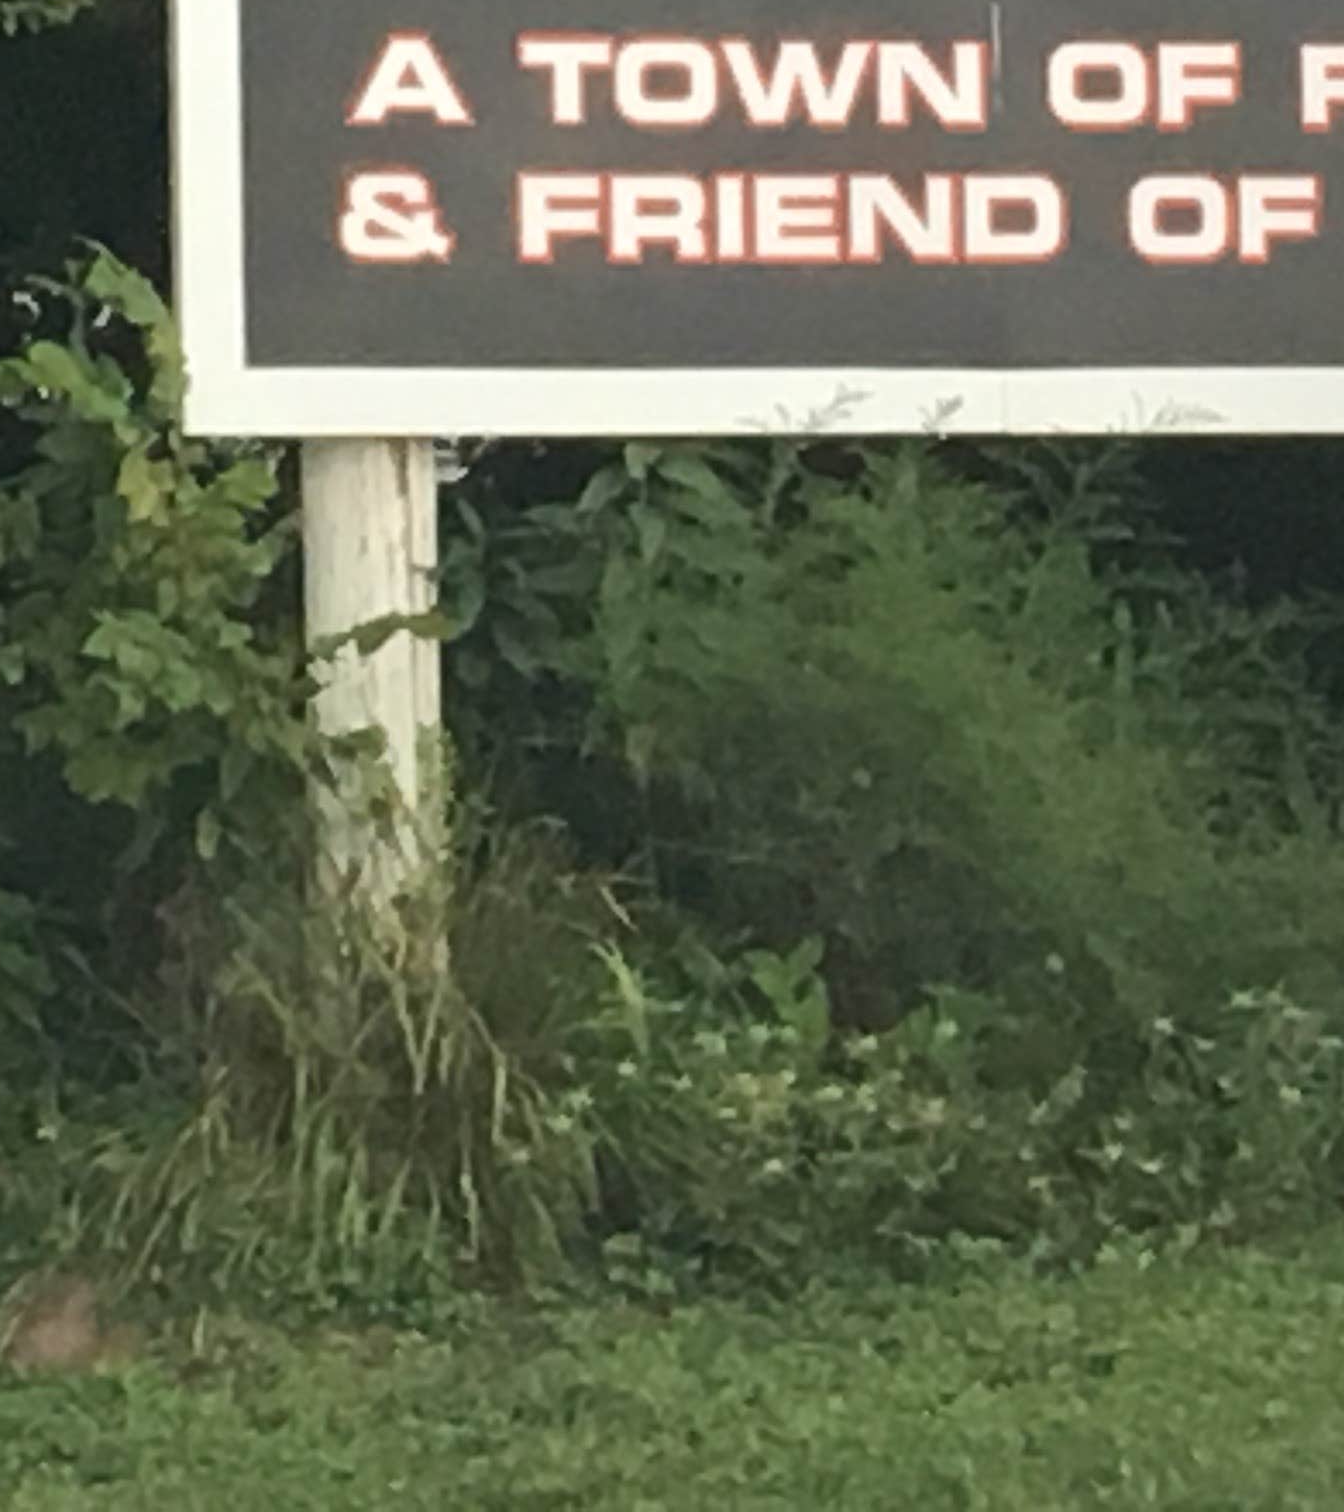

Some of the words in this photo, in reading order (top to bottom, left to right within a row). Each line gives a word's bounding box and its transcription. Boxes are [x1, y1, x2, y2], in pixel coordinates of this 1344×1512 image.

[346, 33, 474, 126] A
[515, 34, 989, 130] TOWN
[1046, 40, 1240, 131] OF
[337, 171, 450, 264] &
[515, 172, 1065, 266] FRIEND
[1126, 173, 1318, 266] OF
